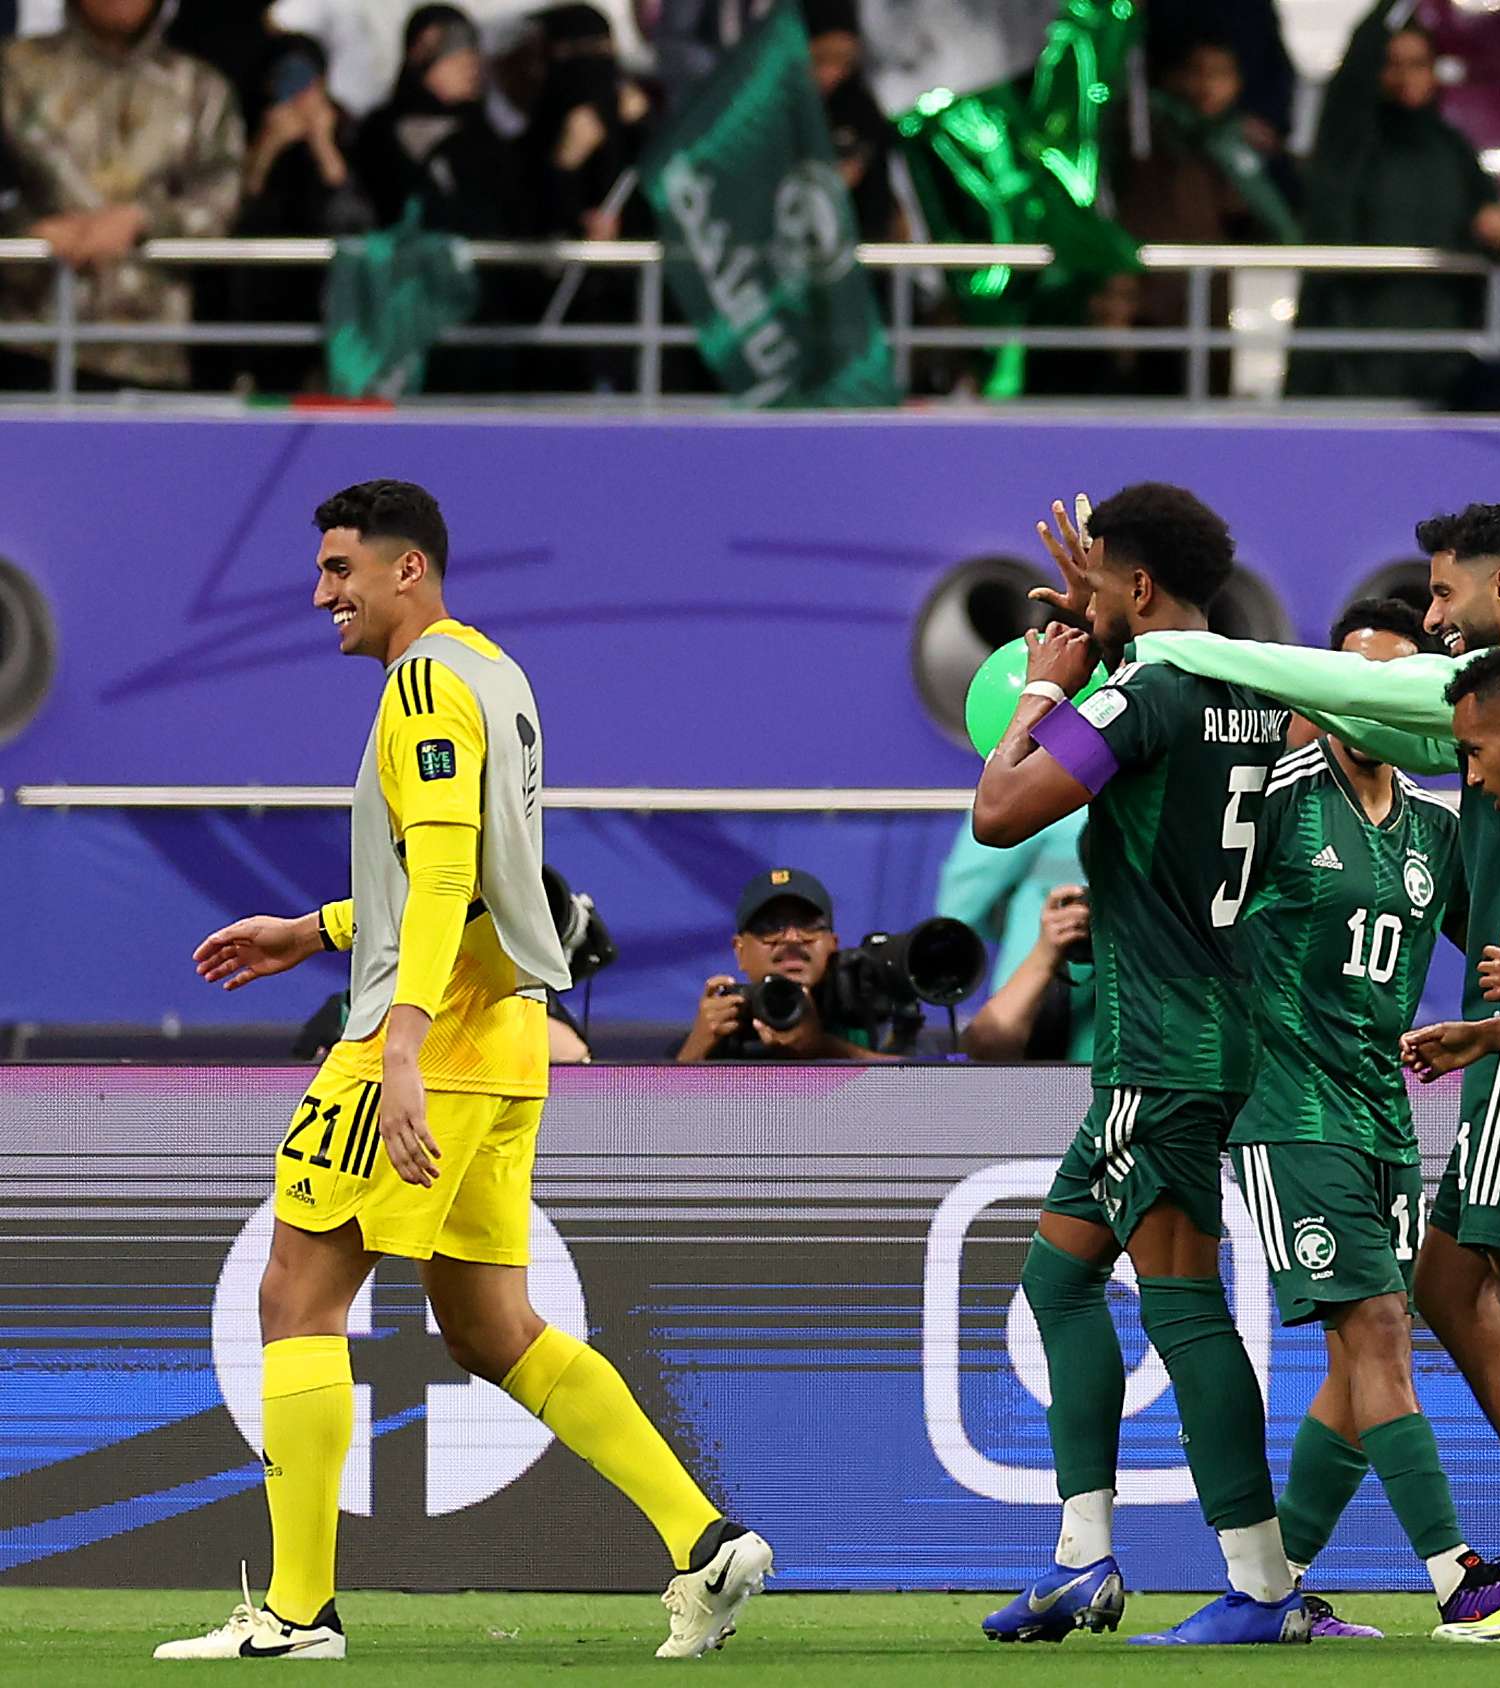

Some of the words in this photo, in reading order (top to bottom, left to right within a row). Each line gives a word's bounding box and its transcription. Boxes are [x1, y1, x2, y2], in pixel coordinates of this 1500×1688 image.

[1211, 765, 1268, 928] 5
[1342, 908, 1403, 984] 10
[281, 1094, 342, 1169] 21
